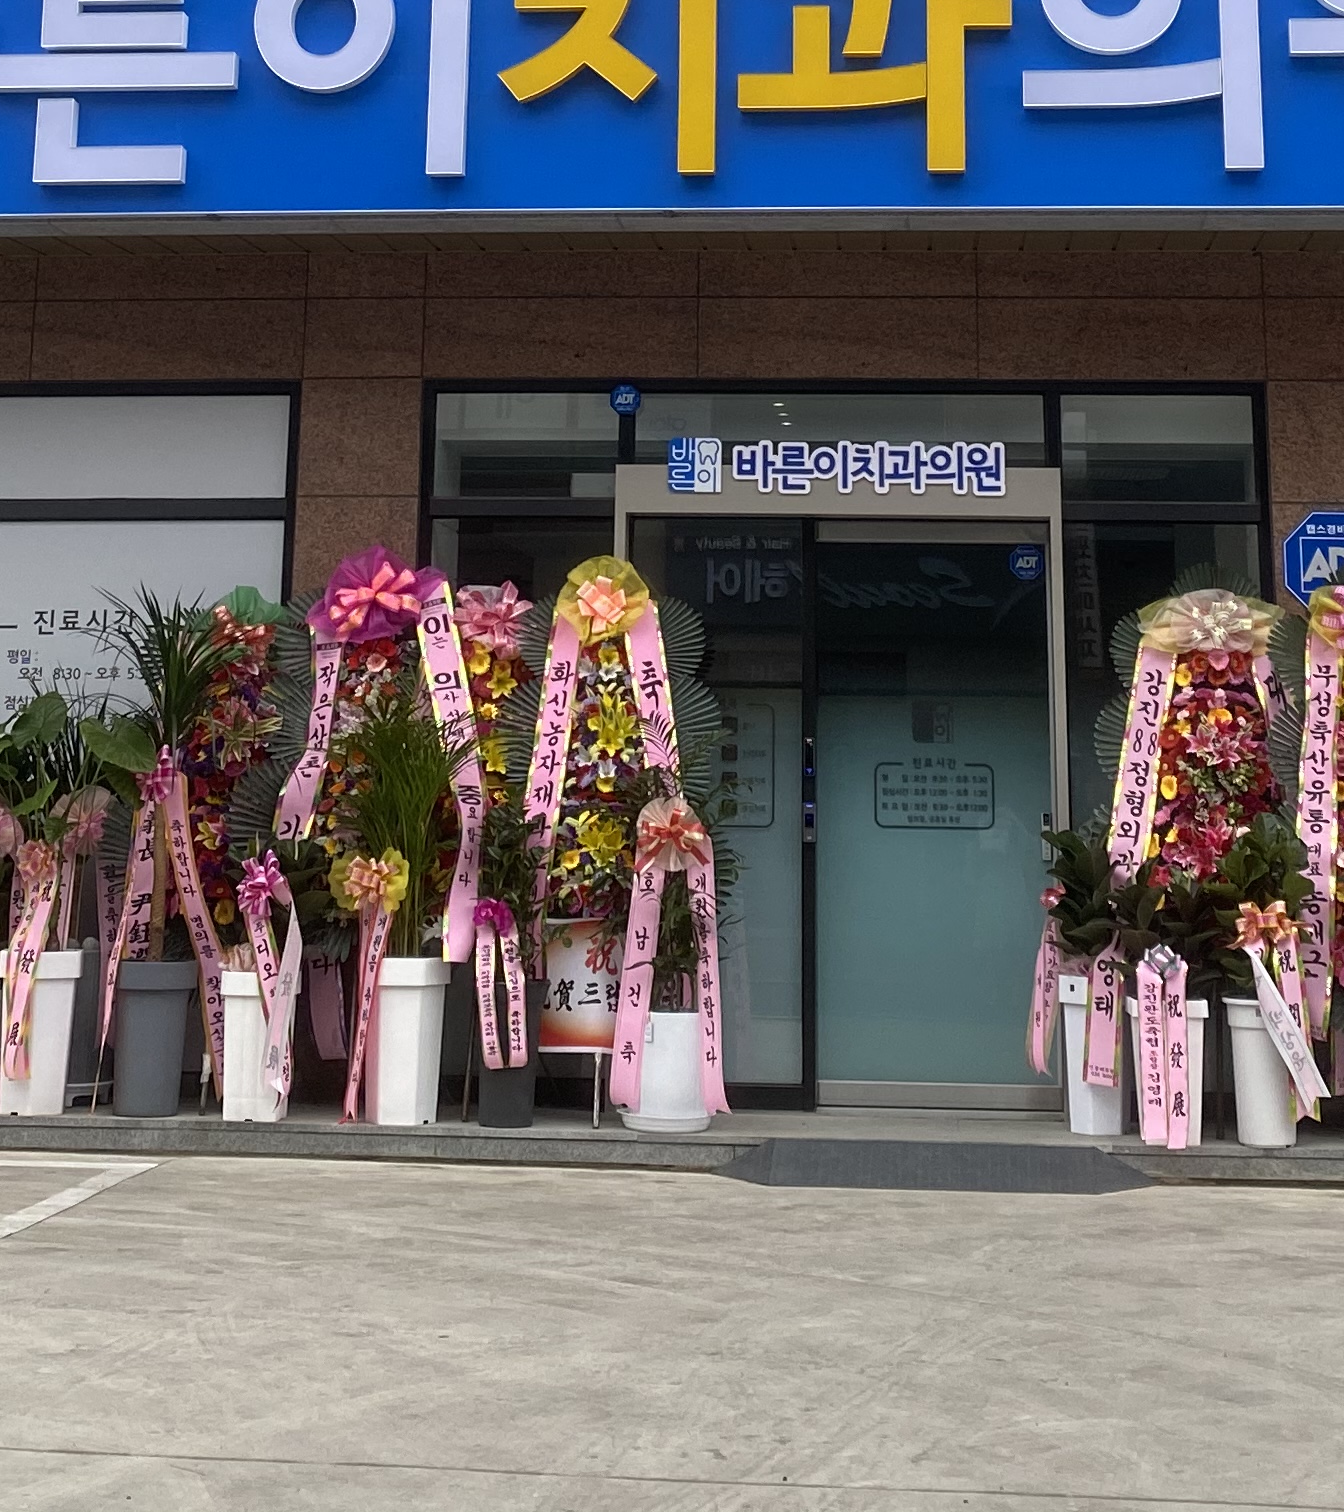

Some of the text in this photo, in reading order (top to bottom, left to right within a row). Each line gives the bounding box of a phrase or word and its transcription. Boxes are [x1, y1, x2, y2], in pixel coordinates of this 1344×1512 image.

[613, 391, 639, 410] ADT
[734, 441, 1005, 495] 바른이치과의원
[1012, 550, 1040, 572] ADT
